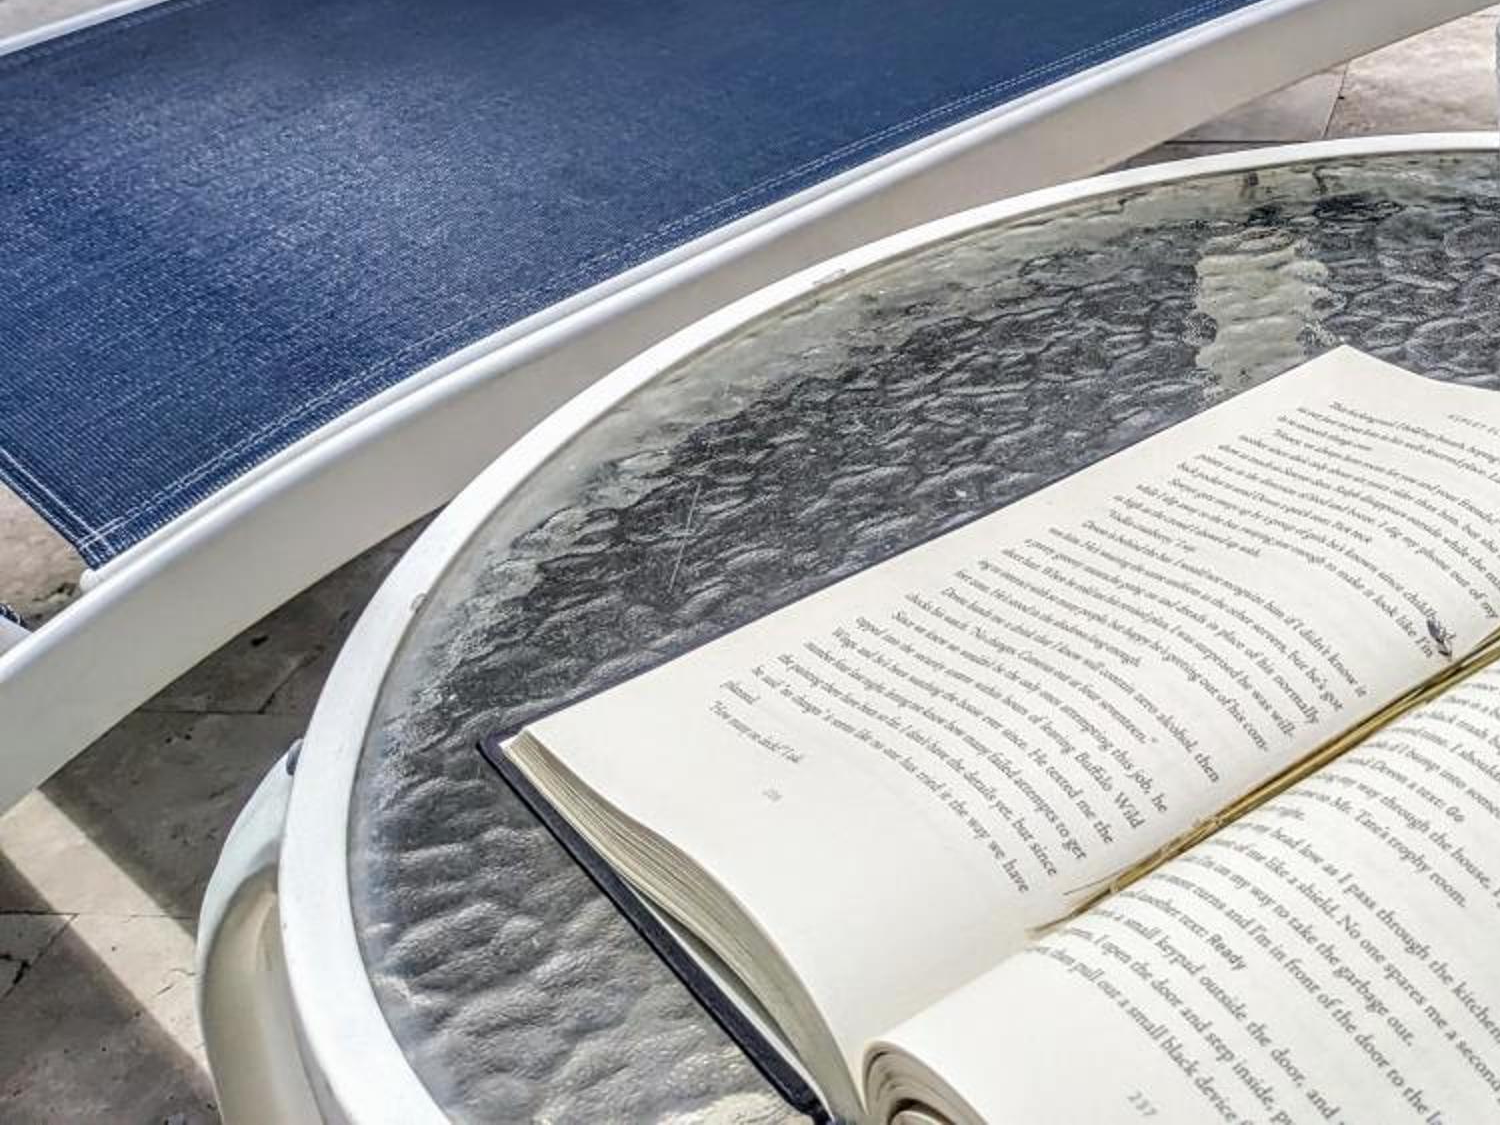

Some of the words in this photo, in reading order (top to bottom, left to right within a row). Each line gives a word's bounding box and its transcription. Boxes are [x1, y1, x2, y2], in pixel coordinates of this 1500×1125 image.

[1387, 837, 1431, 873] trophy
[1445, 807, 1464, 822] Go
[1206, 934, 1246, 971] Ready
[1288, 917, 1318, 944] take
[1333, 966, 1389, 1016] garbage
[1336, 914, 1360, 939] No
[1360, 939, 1386, 963] one
[1384, 963, 1427, 1006] spares
[1343, 884, 1376, 910] pass
[1376, 909, 1430, 960] through
[1428, 961, 1454, 985] the
[1126, 1007, 1169, 1041] small
[1160, 1036, 1199, 1077] black
[1194, 1077, 1237, 1123] device
[1150, 978, 1184, 1007] door
[1180, 1008, 1213, 1033] and
[1204, 1033, 1235, 1062] step
[1154, 935, 1206, 976] keypad
[1199, 976, 1247, 1022] outside
[1246, 1022, 1272, 1047] the
[1306, 1089, 1341, 1120] and
[1283, 958, 1320, 994] front
[1332, 1009, 1357, 1033] the
[1354, 1034, 1390, 1068] door
[1402, 1087, 1429, 1114] the
[1127, 1091, 1158, 1116] 237
